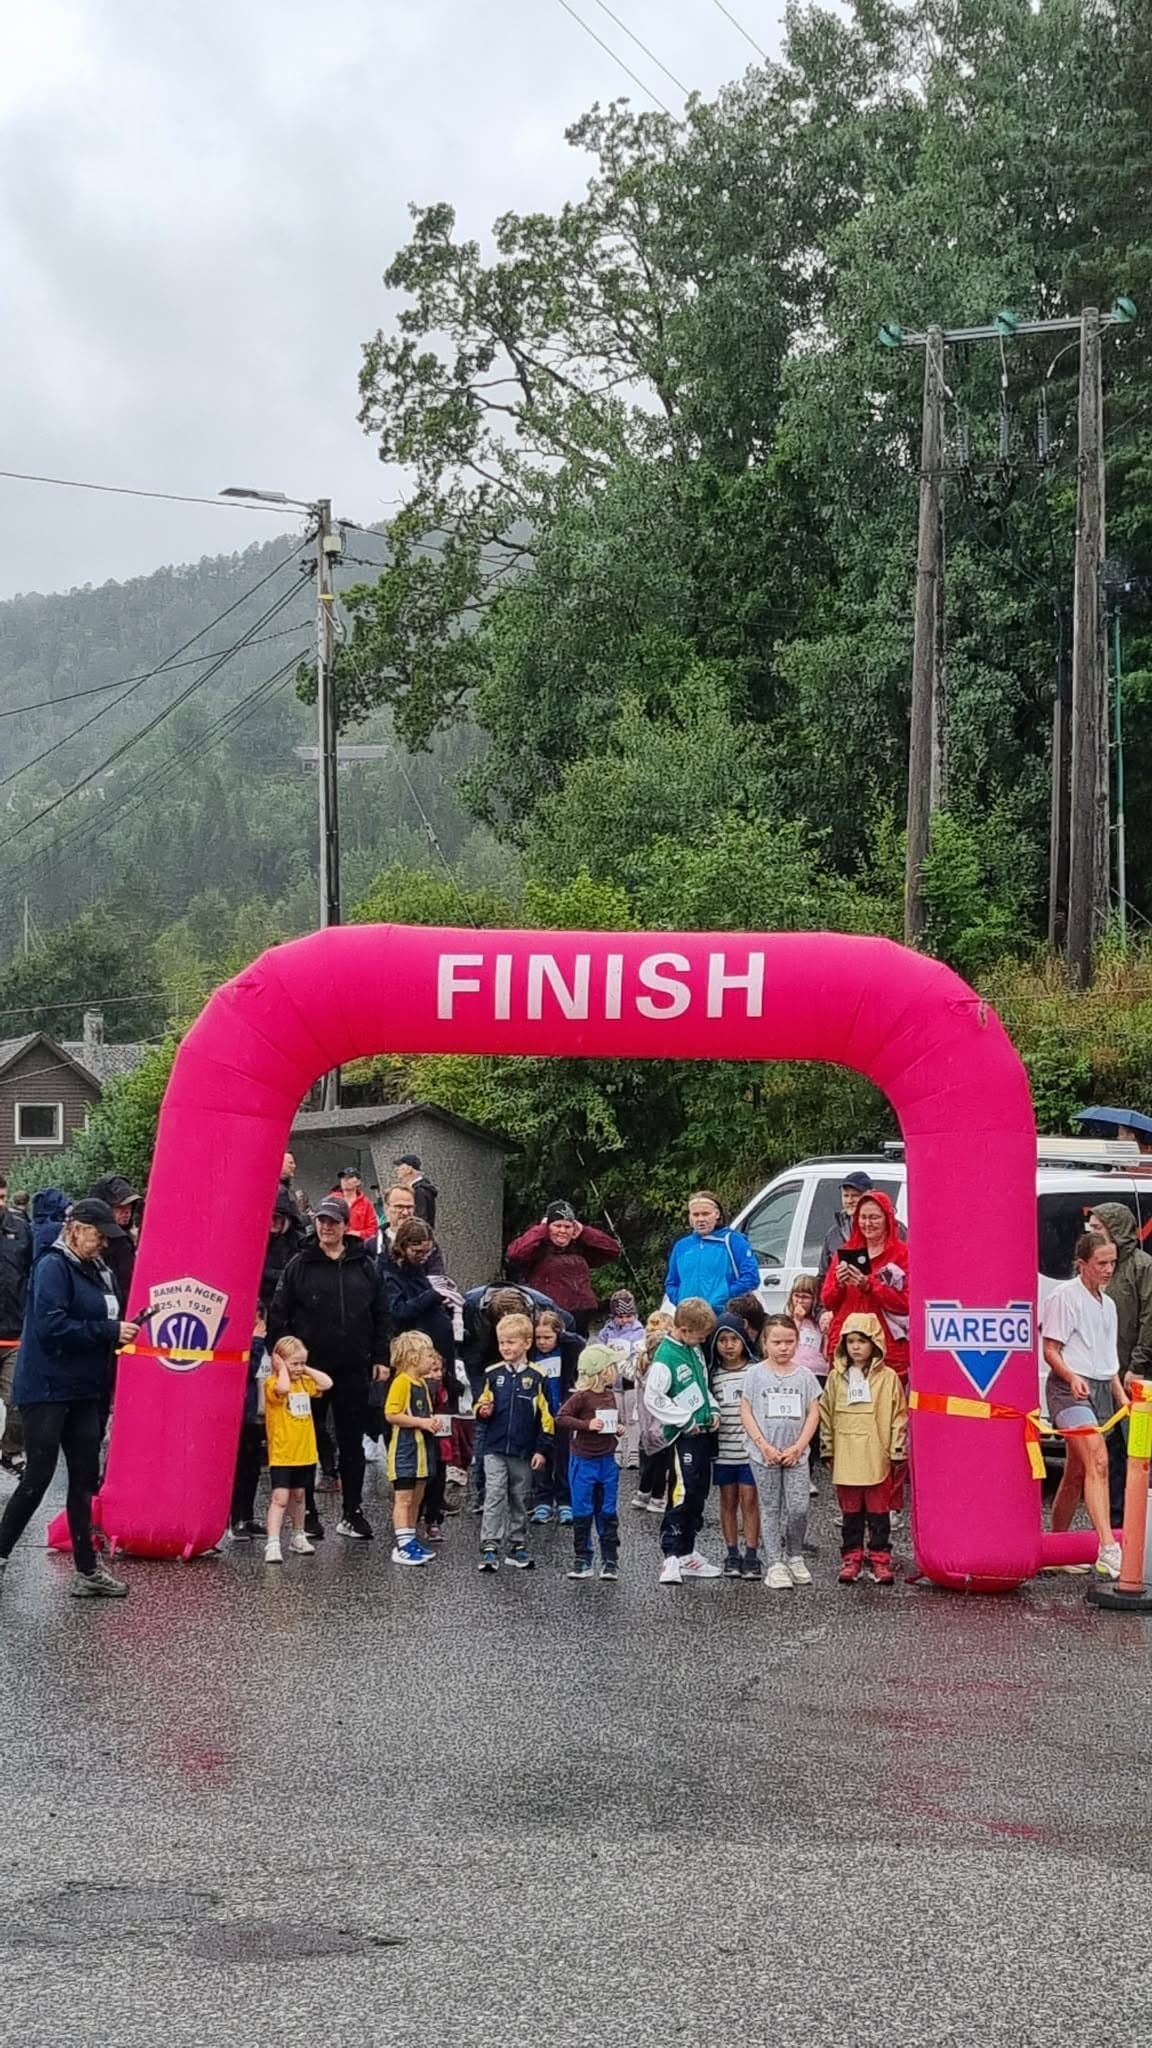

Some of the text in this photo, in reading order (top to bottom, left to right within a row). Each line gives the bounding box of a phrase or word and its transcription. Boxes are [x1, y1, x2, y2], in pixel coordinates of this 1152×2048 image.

[437, 952, 766, 1020] FINISH
[189, 1300, 212, 1315] 1936
[930, 1317, 1029, 1343] VAREGG
